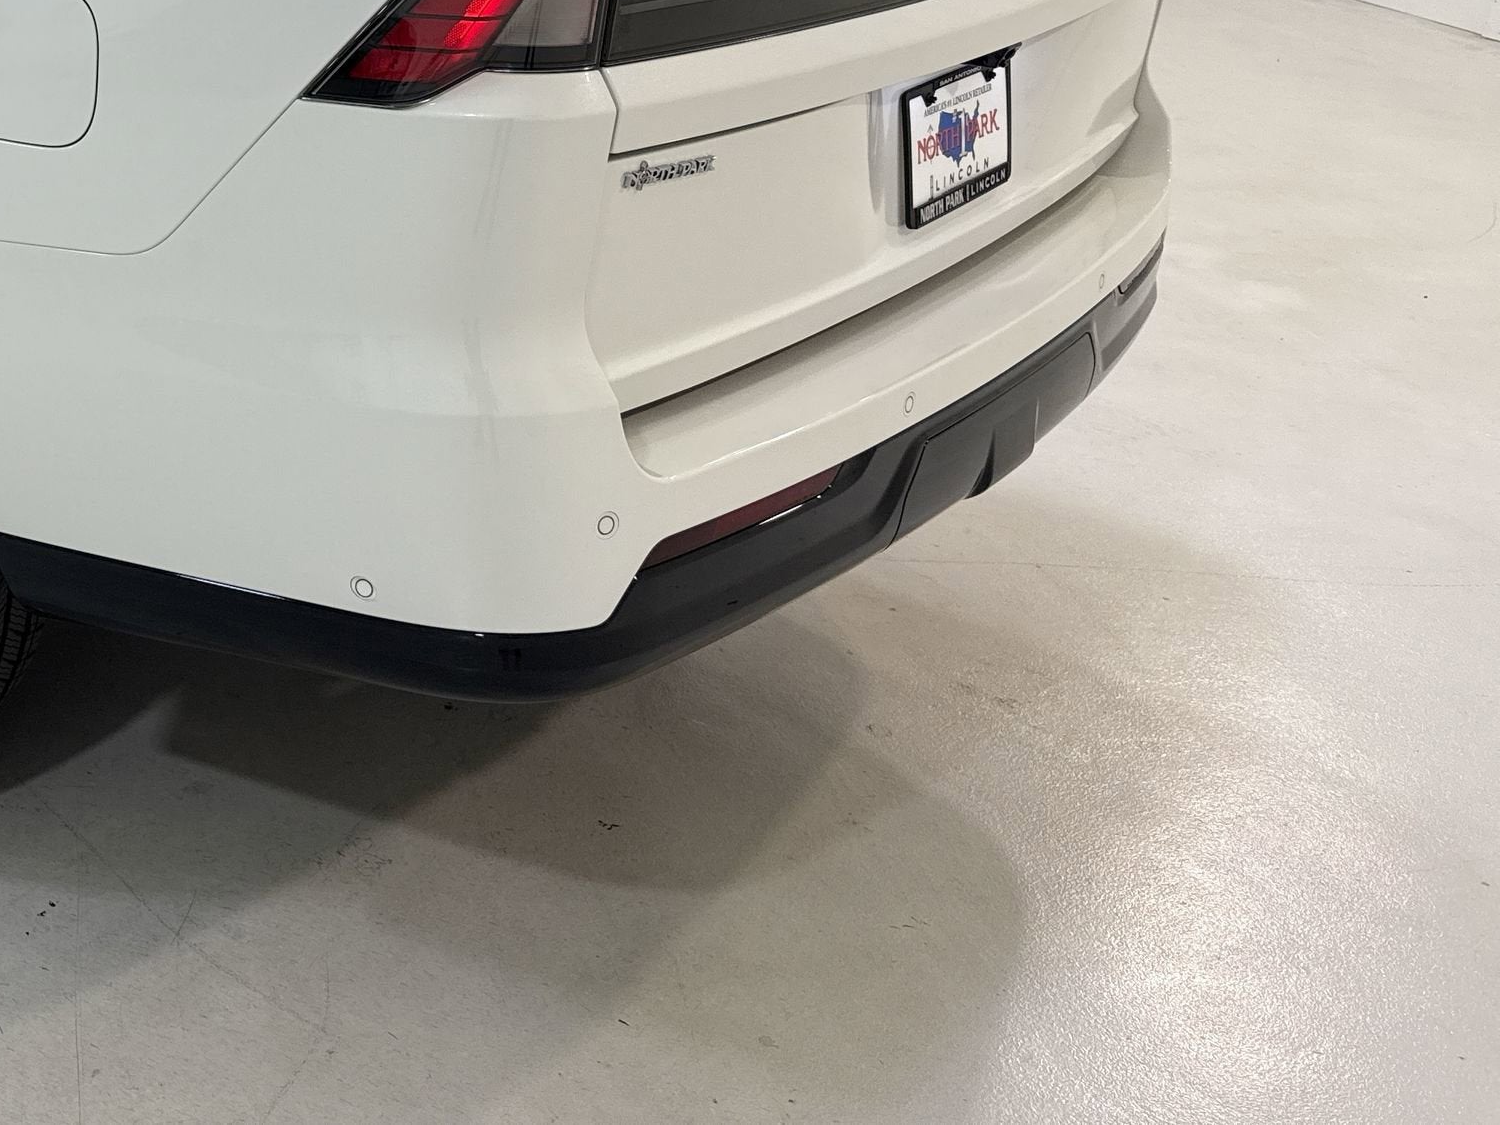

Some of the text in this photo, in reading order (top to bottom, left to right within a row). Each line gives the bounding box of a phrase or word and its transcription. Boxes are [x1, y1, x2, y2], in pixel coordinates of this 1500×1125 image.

[939, 66, 982, 86] SAN ANTONIO
[953, 91, 973, 106] LINCOLN
[917, 108, 1000, 164] NORTH PARK
[935, 157, 990, 191] LINCOLN
[920, 169, 1007, 224] NORTH PARK LINCOLN
